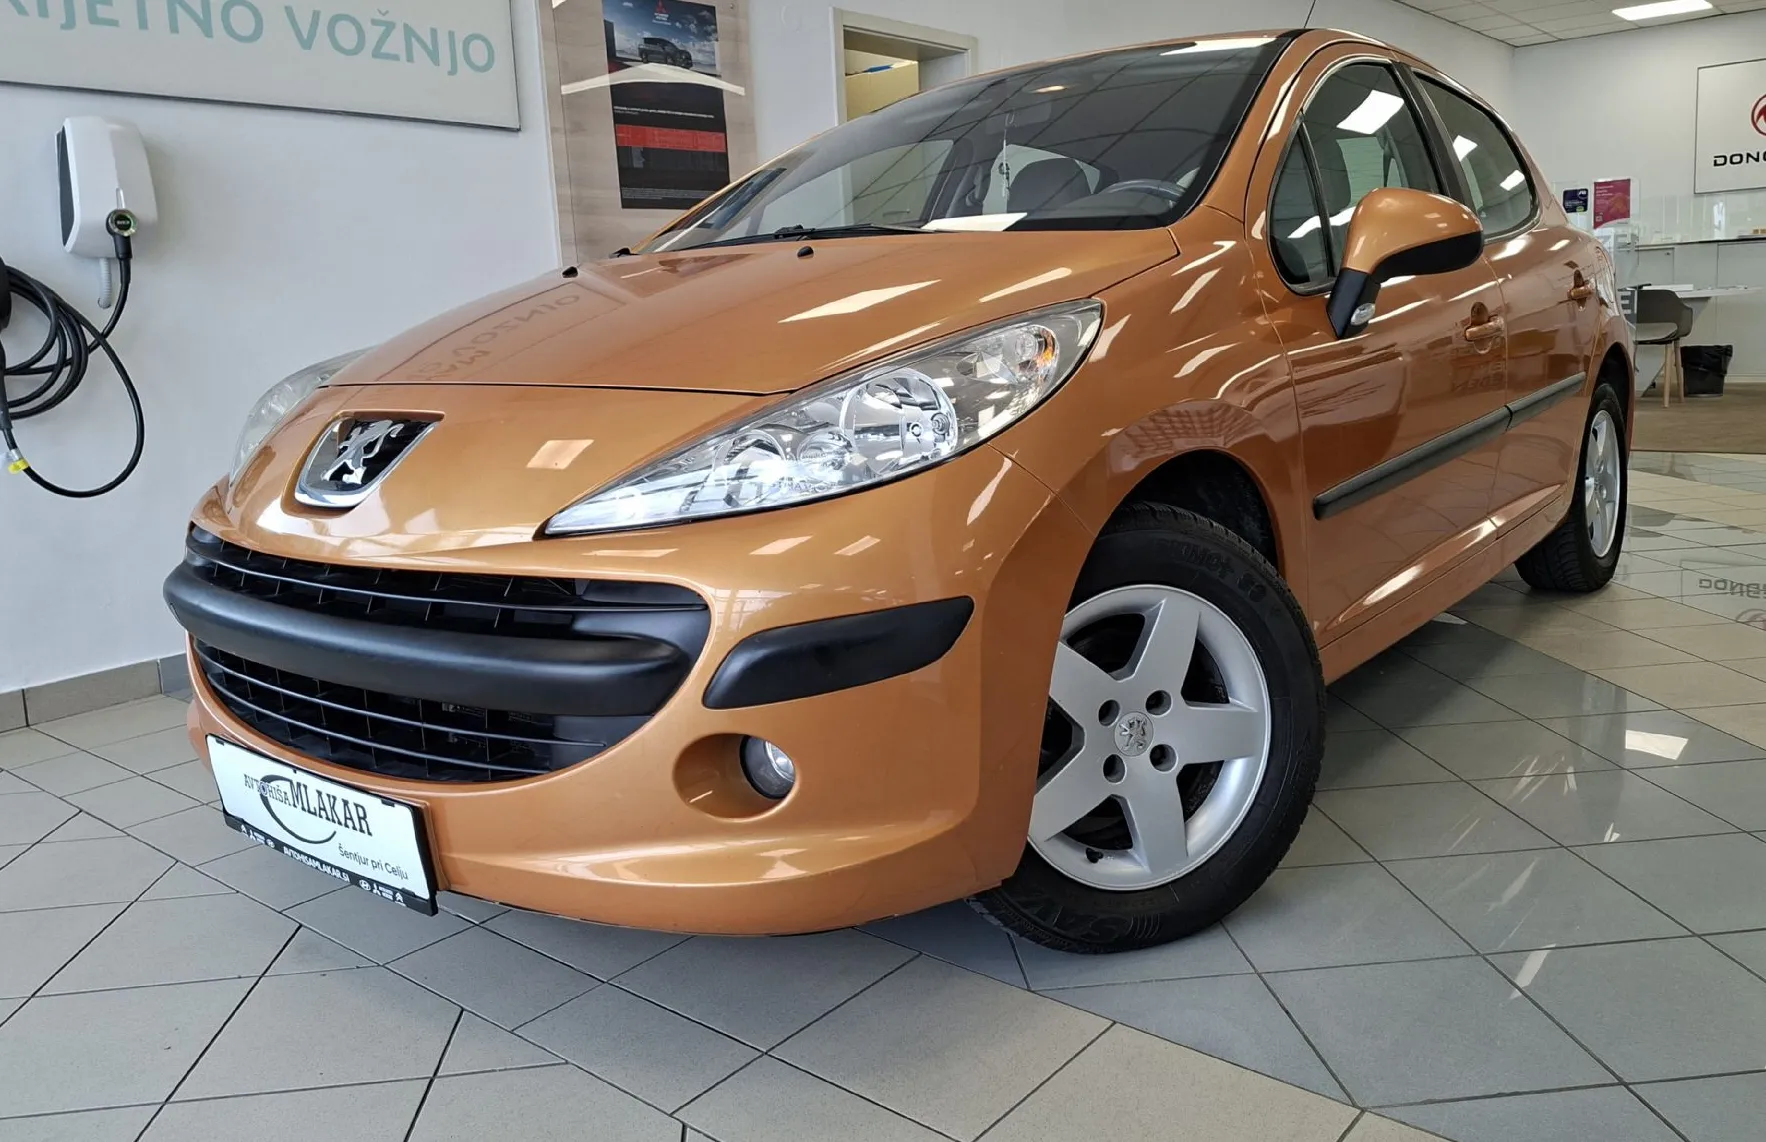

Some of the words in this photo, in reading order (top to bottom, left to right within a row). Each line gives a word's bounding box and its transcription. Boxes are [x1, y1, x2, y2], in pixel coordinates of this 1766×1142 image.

[284, 5, 495, 76] VOŽNJO
[1713, 151, 1766, 167] DON
[290, 780, 373, 837] MLAKAR
[338, 843, 369, 866] Šentjur
[371, 859, 384, 871] pri
[385, 862, 408, 880] Celju
